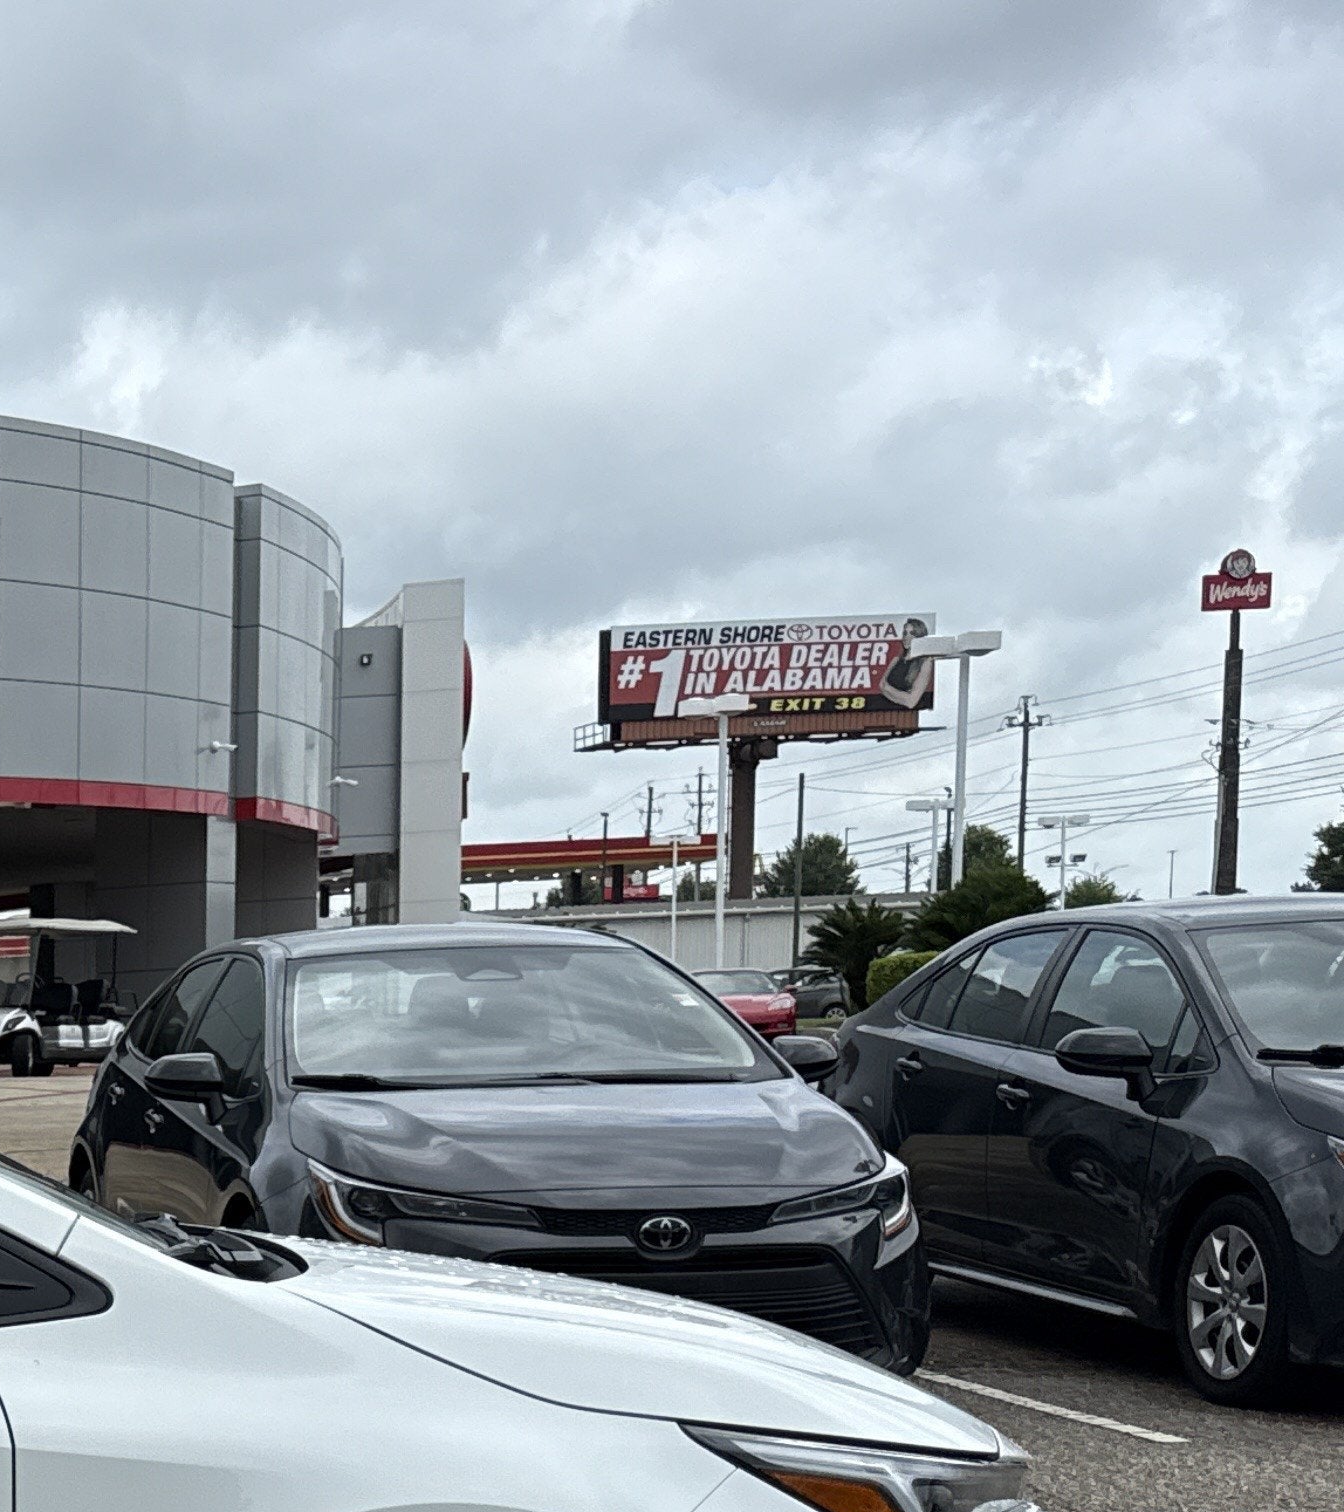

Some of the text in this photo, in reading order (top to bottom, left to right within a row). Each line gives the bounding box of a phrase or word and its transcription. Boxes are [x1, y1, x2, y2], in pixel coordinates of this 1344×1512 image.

[1209, 578, 1268, 604] Wendy's
[623, 622, 898, 649] EASTERN SHORE TOYOTA
[688, 642, 889, 672] TOYOTA DEALER
[683, 667, 871, 695] IN ALABAMA
[770, 697, 866, 711] EXIT 38
